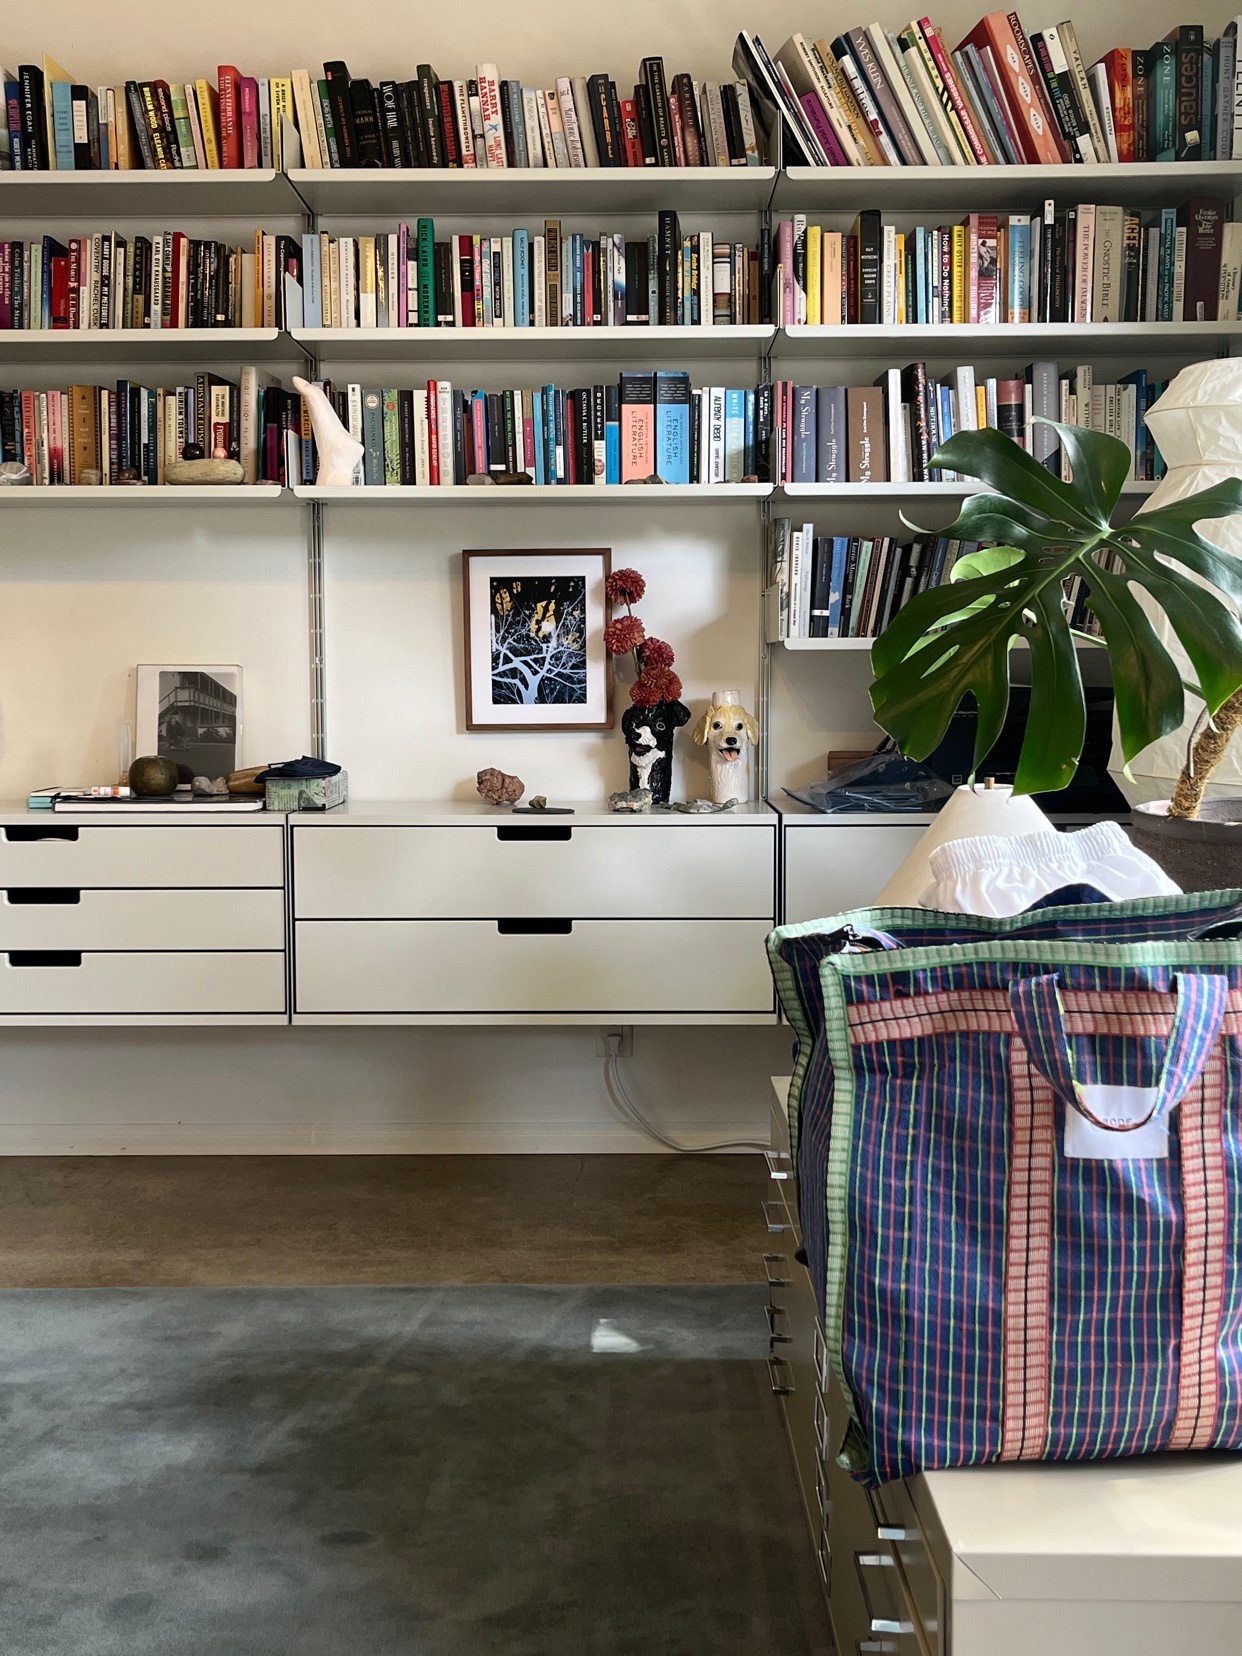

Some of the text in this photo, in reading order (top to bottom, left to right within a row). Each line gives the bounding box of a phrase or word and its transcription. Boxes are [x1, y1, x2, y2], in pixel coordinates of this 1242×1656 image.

[855, 36, 885, 90] YVES KLEIN
[1008, 14, 1036, 76] ROOMSCAPES
[1036, 40, 1052, 73] REVOLUTION
[652, 63, 658, 71] IN
[810, 47, 833, 90] David Hockney
[1120, 53, 1128, 92] ZONE
[1136, 56, 1145, 95] ZONE
[1163, 45, 1171, 84] ZONE
[22, 71, 31, 109] JENNIFER
[478, 76, 491, 122] HANNAH
[487, 79, 498, 116] BARRY
[510, 81, 520, 123] JOY WILLIAMS
[654, 84, 662, 108] GARDEN
[826, 52, 861, 119] COUNTRY WOMEN
[1009, 52, 1041, 130] THE OPEN ROAD
[1050, 79, 1058, 89] THE
[1052, 88, 1063, 99] EYE
[1072, 49, 1088, 91] YALLAH
[1090, 123, 1101, 144] BOWLES
[1180, 52, 1197, 125] sauces
[224, 76, 234, 134] ELENA FERRANTE
[382, 84, 400, 157] WOLF HALL HILARY
[682, 77, 694, 133] WARLIGHT
[142, 87, 167, 170] BIRNAM WOOD ELEANOR CAT
[221, 128, 227, 137] OF
[427, 117, 435, 136] louise
[440, 91, 457, 160] MASTER MARGARITA
[459, 98, 471, 153] FLAMETHROWERS
[564, 107, 583, 168] Marilynne Robinson
[658, 117, 666, 137] BEASTS
[846, 124, 859, 145] Abrams
[428, 137, 438, 164] kennedy
[487, 145, 495, 163] HAPPY
[102, 241, 110, 258] HARRY
[164, 237, 172, 249] SAM
[420, 224, 429, 244] NICK
[796, 219, 804, 253] RuPaul
[1082, 224, 1090, 242] THE
[1124, 216, 1140, 248] AGEE
[93, 237, 101, 274] COVENTRY
[421, 245, 430, 268] LAIRD
[941, 234, 950, 312] How to Do Nothing
[1017, 240, 1025, 278] FEELING
[1081, 243, 1090, 272] POWER
[1101, 240, 1113, 281] GNOSTIC
[1164, 248, 1172, 269] PLANTS
[1175, 231, 1186, 303] documentary erik barnouw
[102, 286, 108, 295] MY
[162, 276, 172, 317] SARAHLAND
[955, 270, 963, 303] EXPECTING
[1080, 274, 1087, 286] OF
[1101, 282, 1112, 308] BIBLE
[100, 296, 108, 324] METEORITE
[422, 283, 430, 315] MODERN
[955, 305, 963, 323] BETTE
[731, 392, 739, 415] WHITE
[799, 391, 811, 439] My Struggle
[665, 410, 673, 466] LITERATURE
[844, 542, 858, 609] Lorrie Moore Bark
